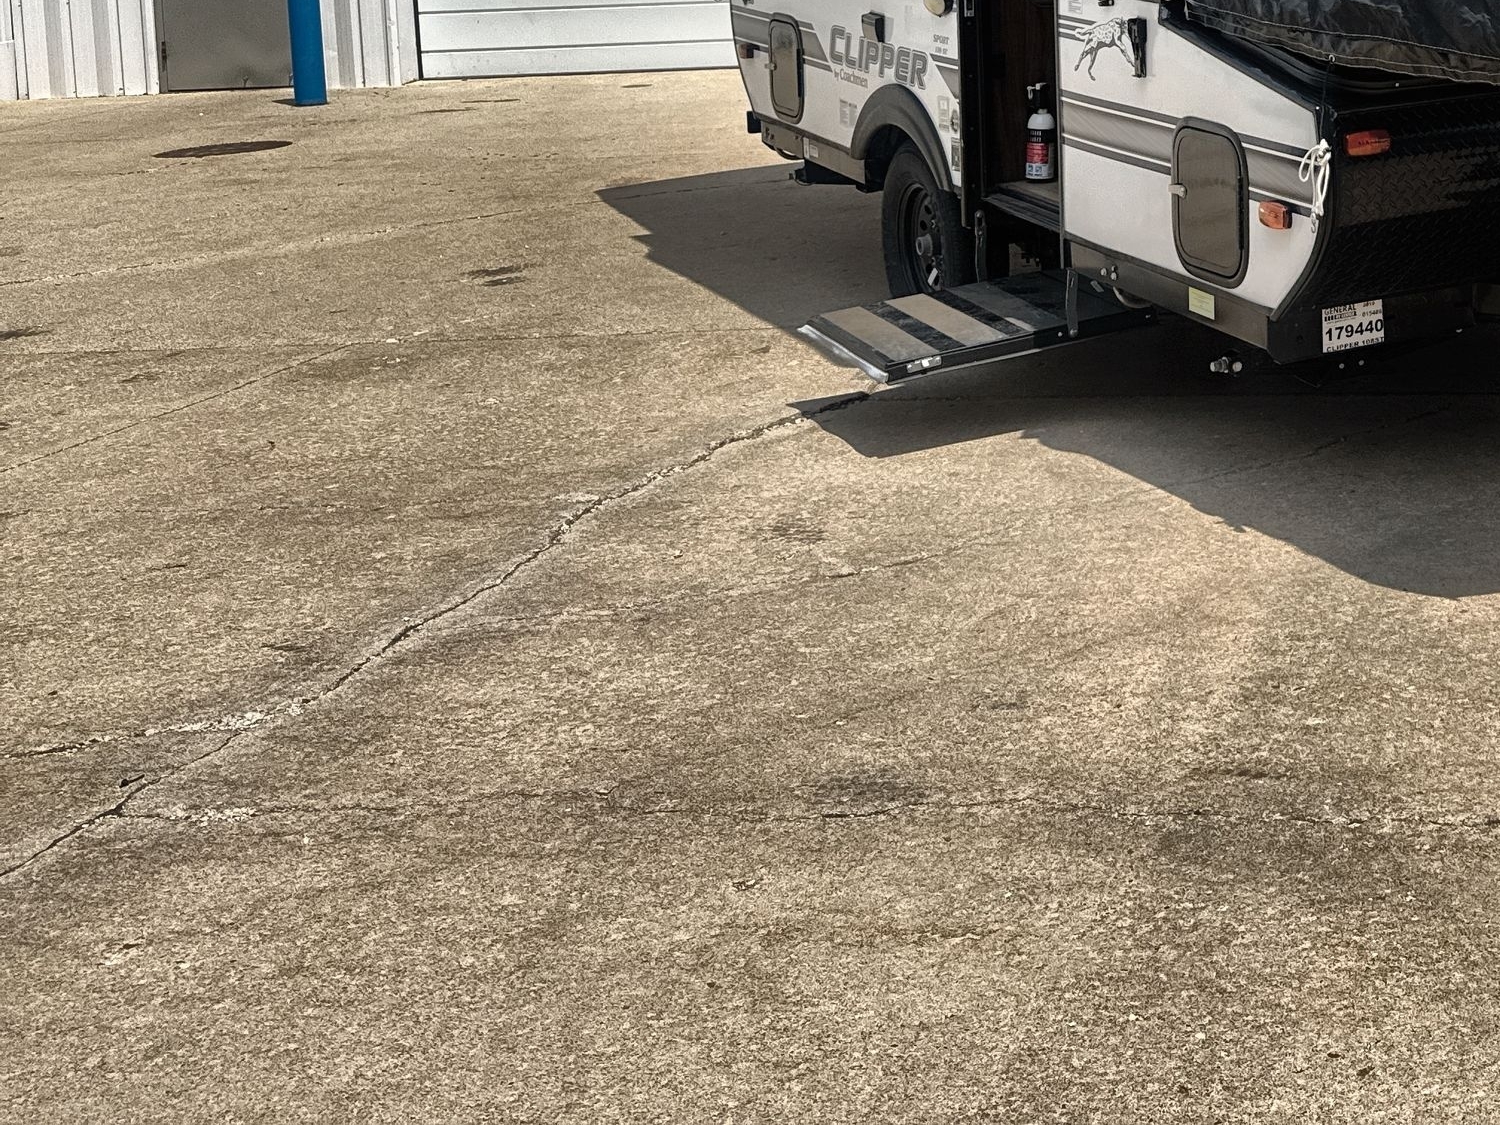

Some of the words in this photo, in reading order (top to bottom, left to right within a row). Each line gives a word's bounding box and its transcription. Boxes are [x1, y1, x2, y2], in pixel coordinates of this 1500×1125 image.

[829, 25, 929, 90] CLIPPER
[1325, 304, 1357, 315] GENERAL
[1325, 319, 1384, 341] 179440
[1326, 341, 1360, 353] CLIPPER
